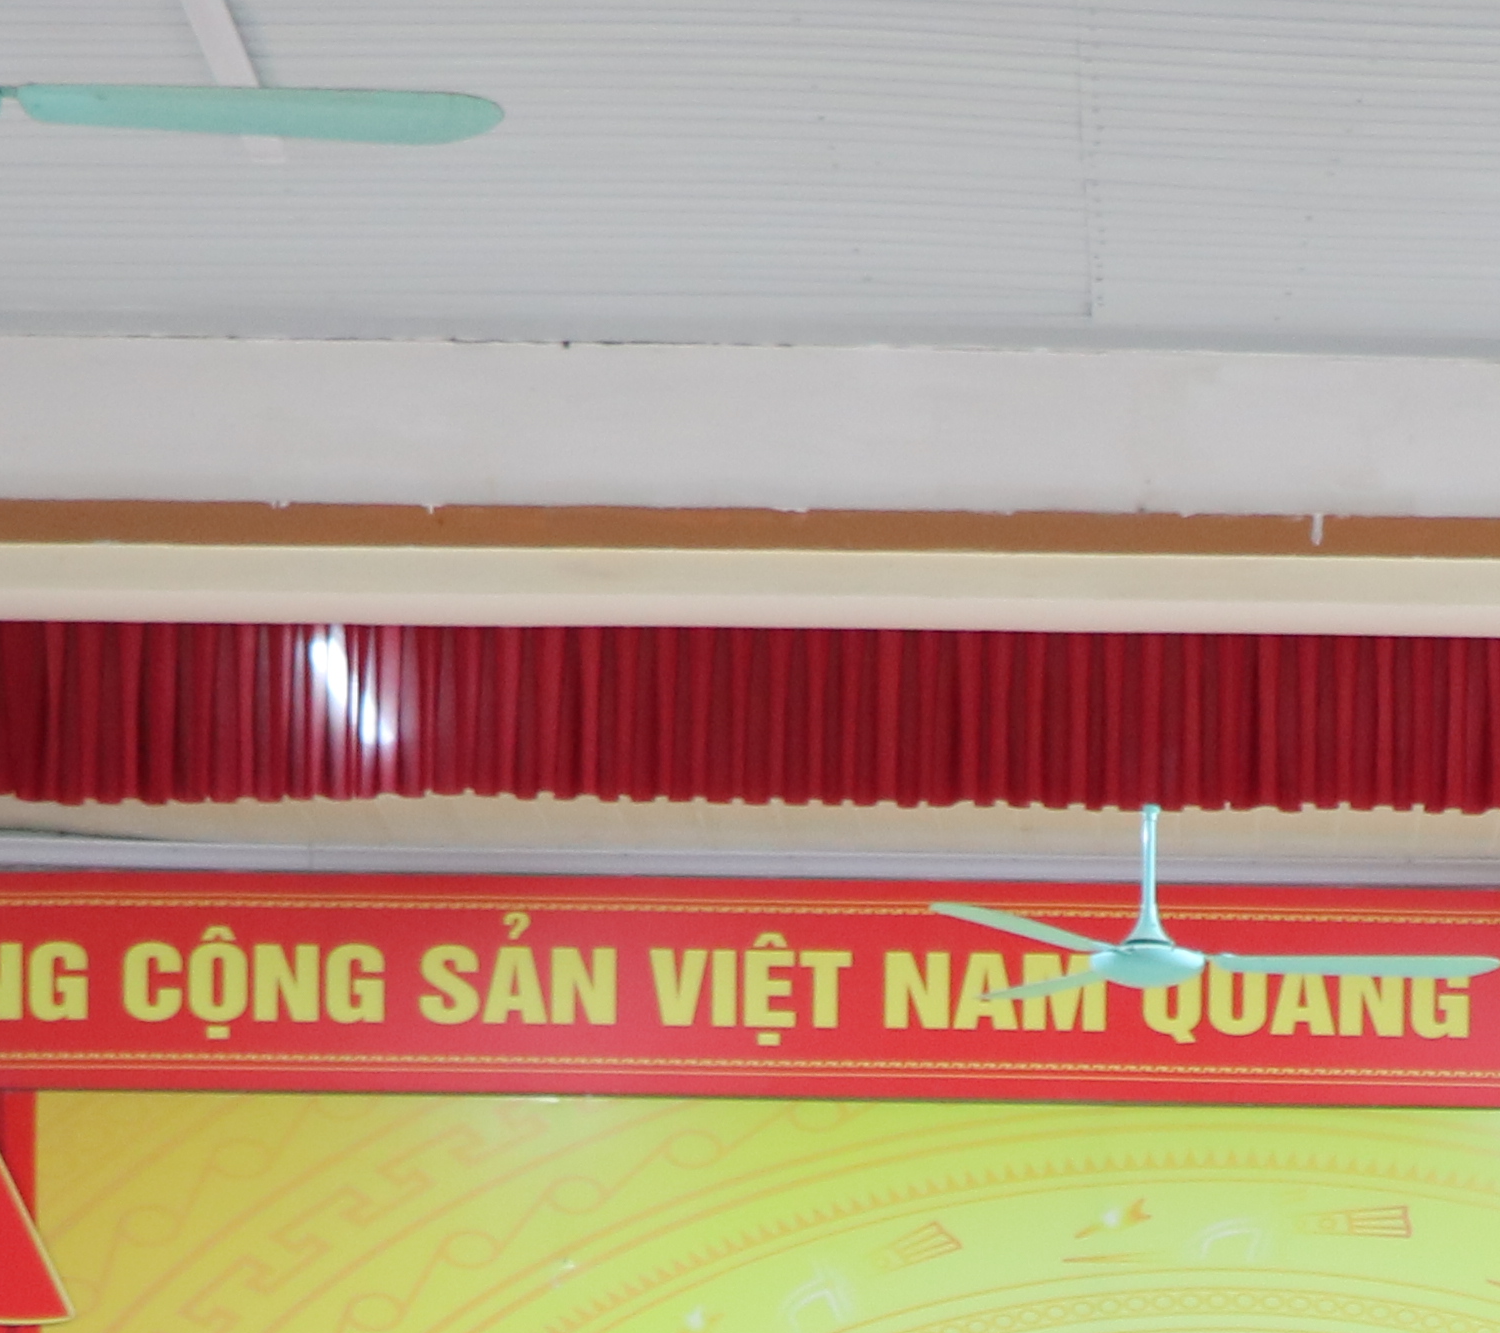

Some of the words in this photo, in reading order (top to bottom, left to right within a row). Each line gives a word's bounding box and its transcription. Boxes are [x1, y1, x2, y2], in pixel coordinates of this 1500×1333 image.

[120, 927, 386, 1036] CỘNG
[419, 912, 618, 1025] SẢN
[651, 932, 855, 1045] VIỆT
[884, 951, 1106, 1032] NAM
[1143, 962, 1471, 1044] QUANG
